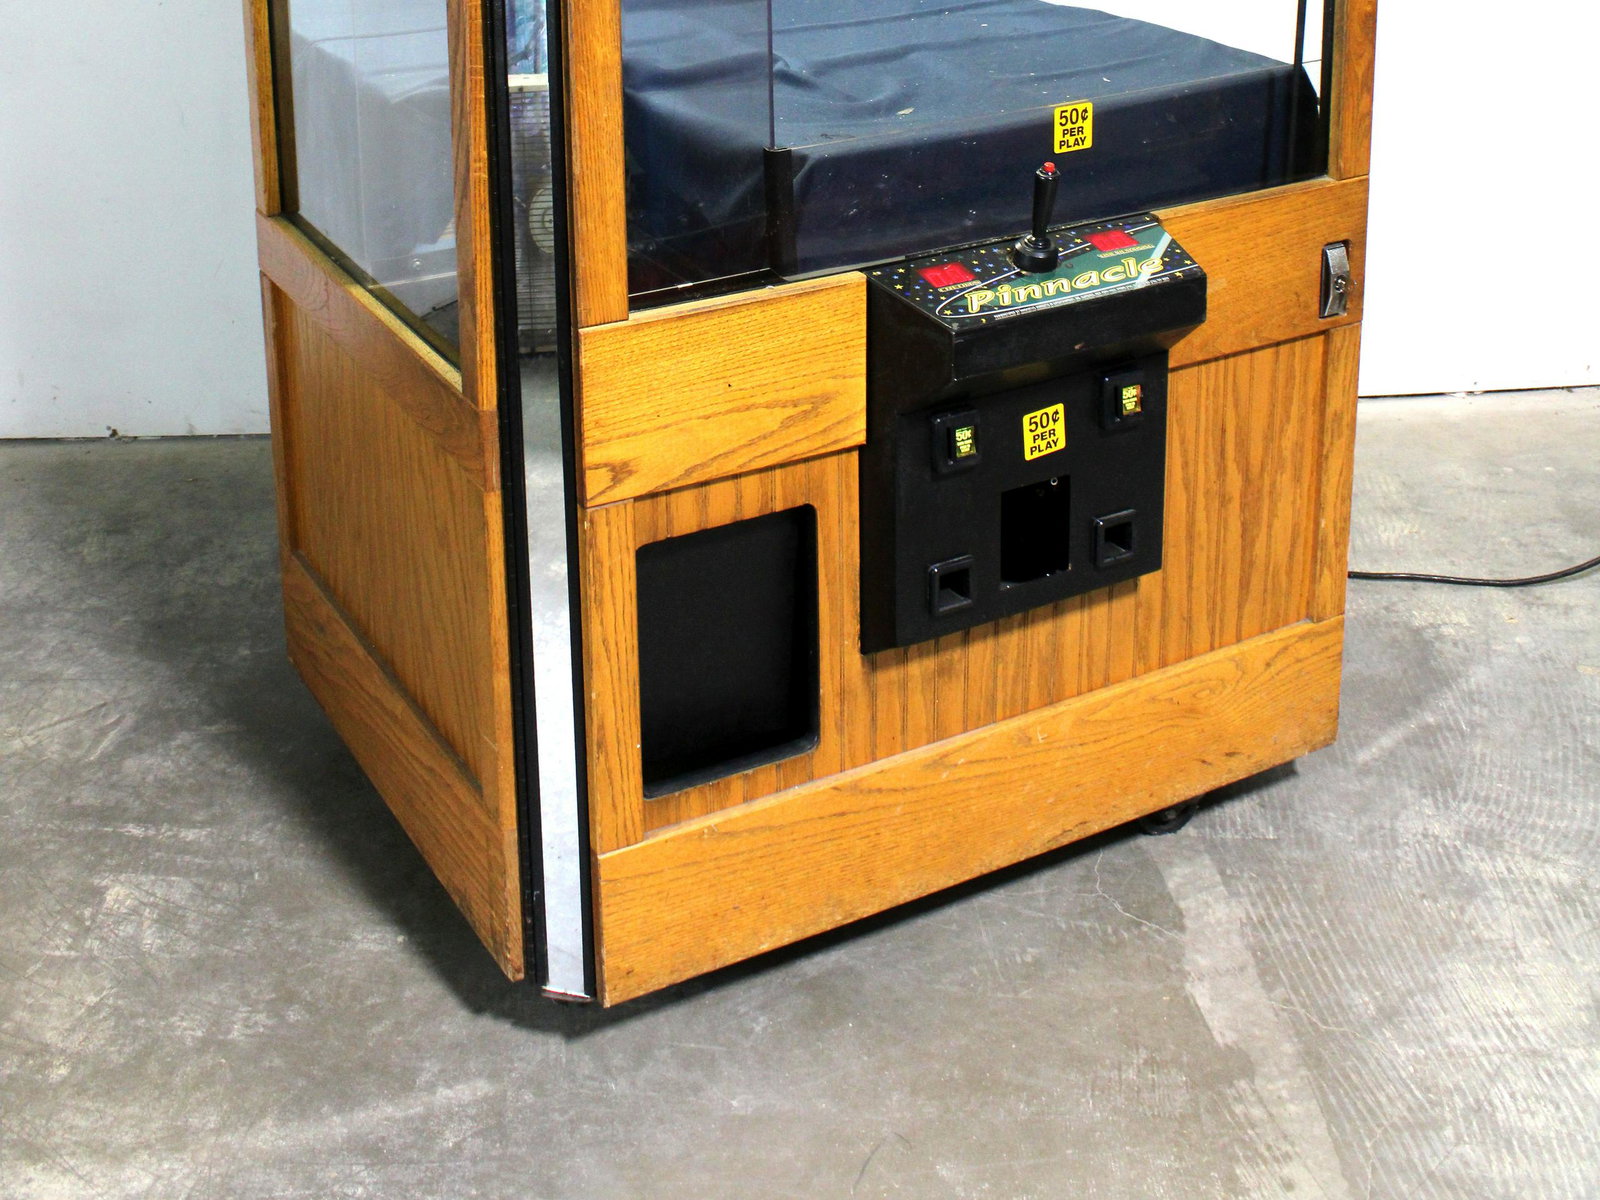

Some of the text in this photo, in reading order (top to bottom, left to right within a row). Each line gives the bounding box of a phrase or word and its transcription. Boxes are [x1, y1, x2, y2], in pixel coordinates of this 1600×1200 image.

[1059, 106, 1089, 126] 50¢
[1062, 127, 1084, 138] PER
[1059, 137, 1087, 149] PLAY
[966, 257, 1164, 314] Pinnacle
[1028, 409, 1060, 433] 50¢
[1033, 428, 1057, 444] PER
[1030, 438, 1059, 456] PLAY
